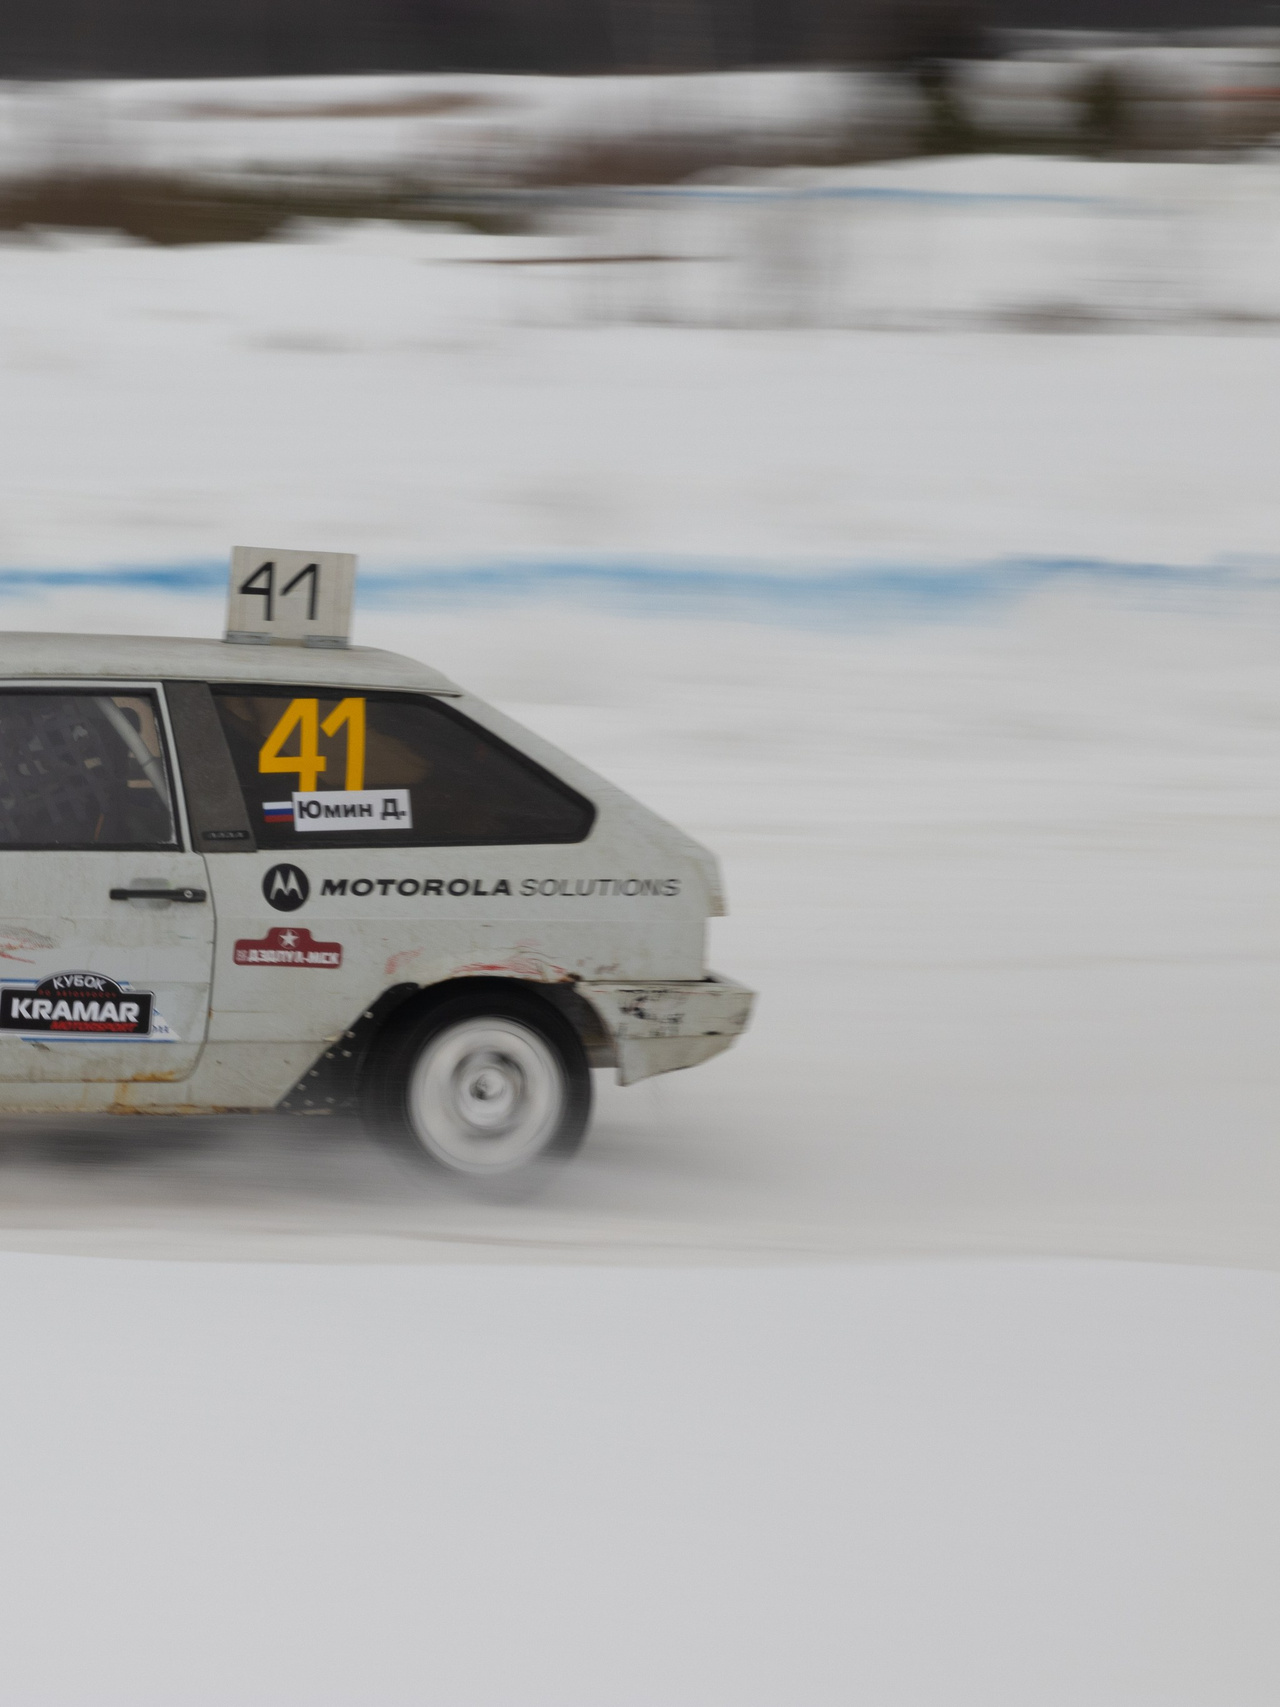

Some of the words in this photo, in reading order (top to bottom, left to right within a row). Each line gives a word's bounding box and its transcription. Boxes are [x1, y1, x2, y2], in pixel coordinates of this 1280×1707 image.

[238, 561, 320, 621] 41
[259, 697, 366, 792] 41
[297, 799, 373, 819] Юмин
[380, 797, 407, 821] Д.
[320, 878, 512, 897] MOTOROLA
[519, 878, 682, 897] SOLUTIONS
[52, 975, 107, 991] КУБОК
[11, 997, 140, 1022] KRAMAR
[50, 1020, 138, 1033] MOTORSPORT
